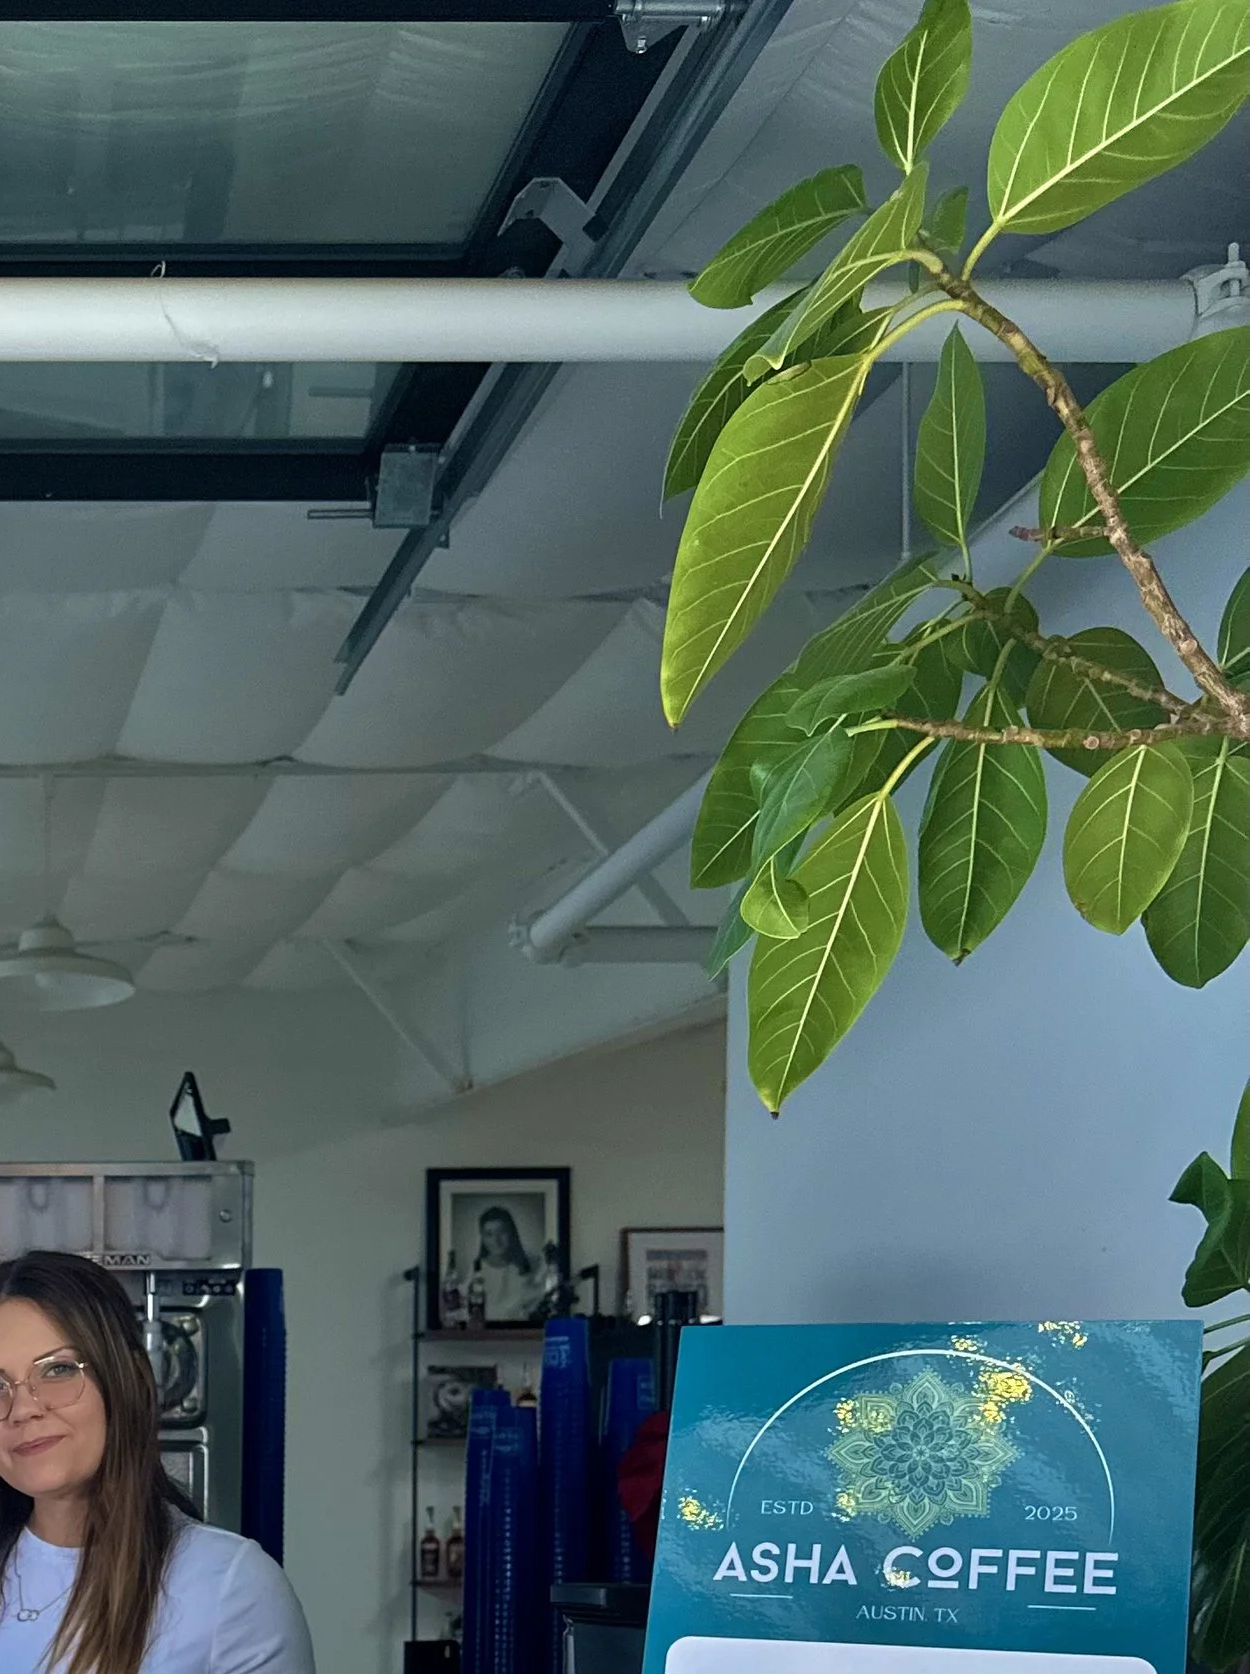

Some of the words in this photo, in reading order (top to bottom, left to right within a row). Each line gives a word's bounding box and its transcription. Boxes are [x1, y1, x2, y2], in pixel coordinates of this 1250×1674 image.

[760, 1500, 814, 1515] ESTD
[1024, 1504, 1078, 1521] 2025
[713, 1541, 858, 1586] ASHA
[934, 1607, 959, 1623] TX
